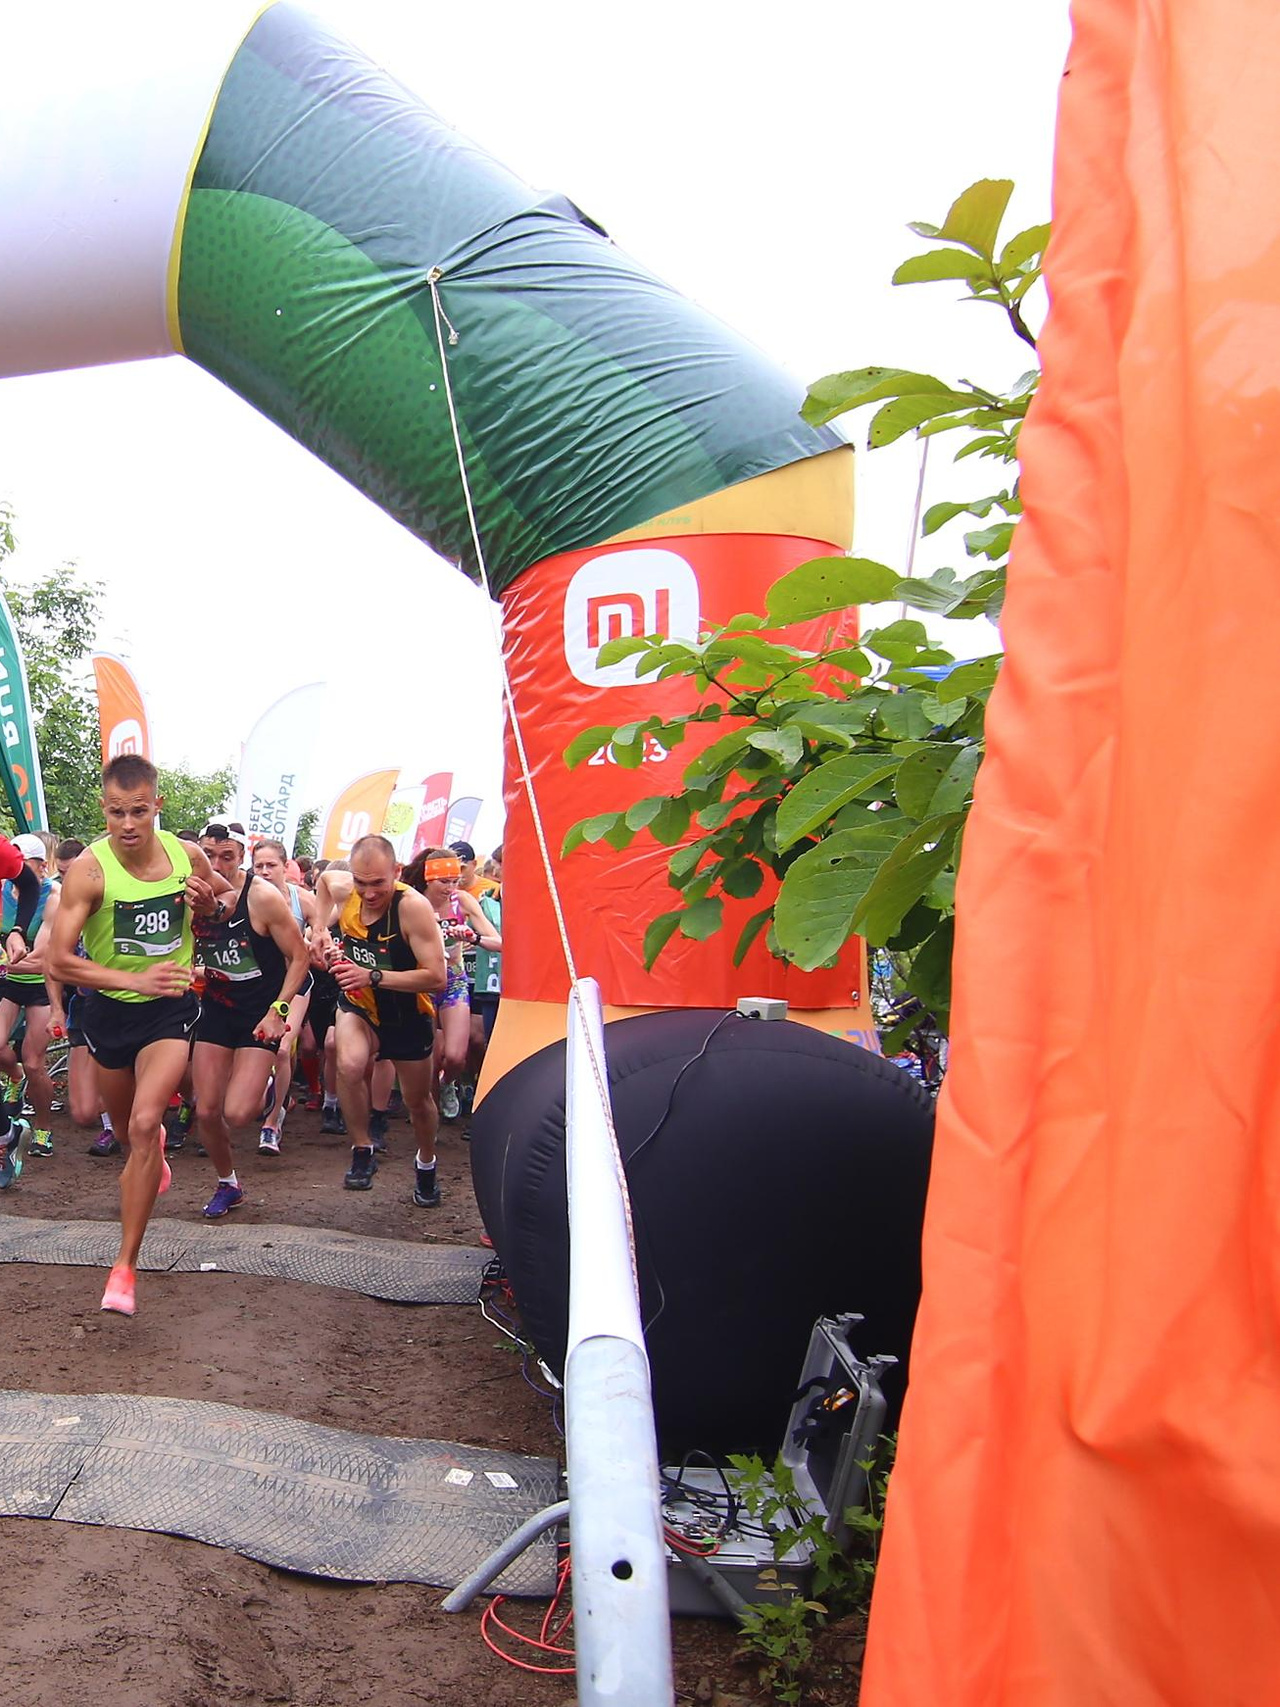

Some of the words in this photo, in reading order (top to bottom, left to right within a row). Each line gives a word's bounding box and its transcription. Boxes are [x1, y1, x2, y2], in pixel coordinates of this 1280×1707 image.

[259, 799, 276, 834] КАК
[134, 909, 170, 935] 298
[120, 943, 129, 953] 5
[213, 949, 241, 966] 143
[352, 945, 377, 967] 636
